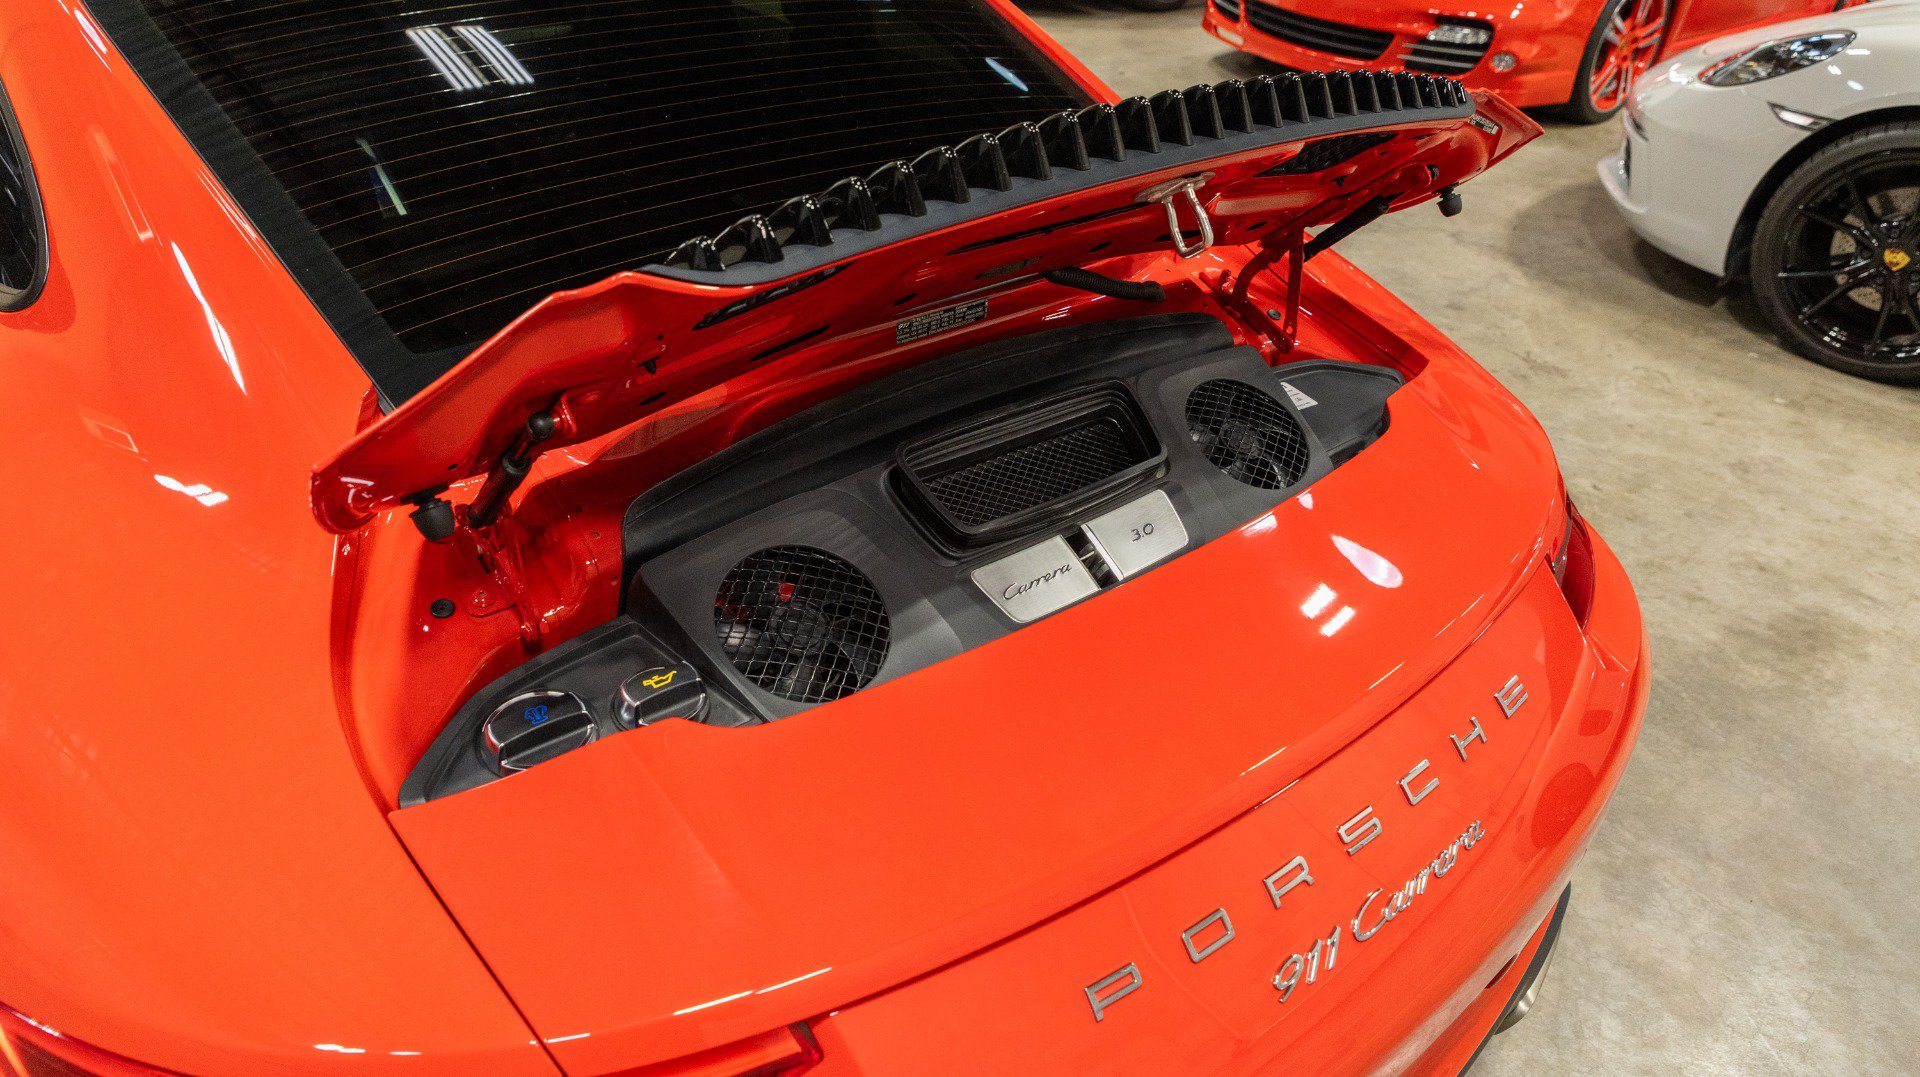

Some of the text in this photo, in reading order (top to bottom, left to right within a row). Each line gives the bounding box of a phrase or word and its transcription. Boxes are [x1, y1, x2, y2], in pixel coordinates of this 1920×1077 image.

[1002, 563, 1073, 601] Carrera
[1131, 522, 1155, 543] 3.0
[1084, 674, 1530, 1022] PORSCHE
[1272, 820, 1487, 1004] 911 Carrera
